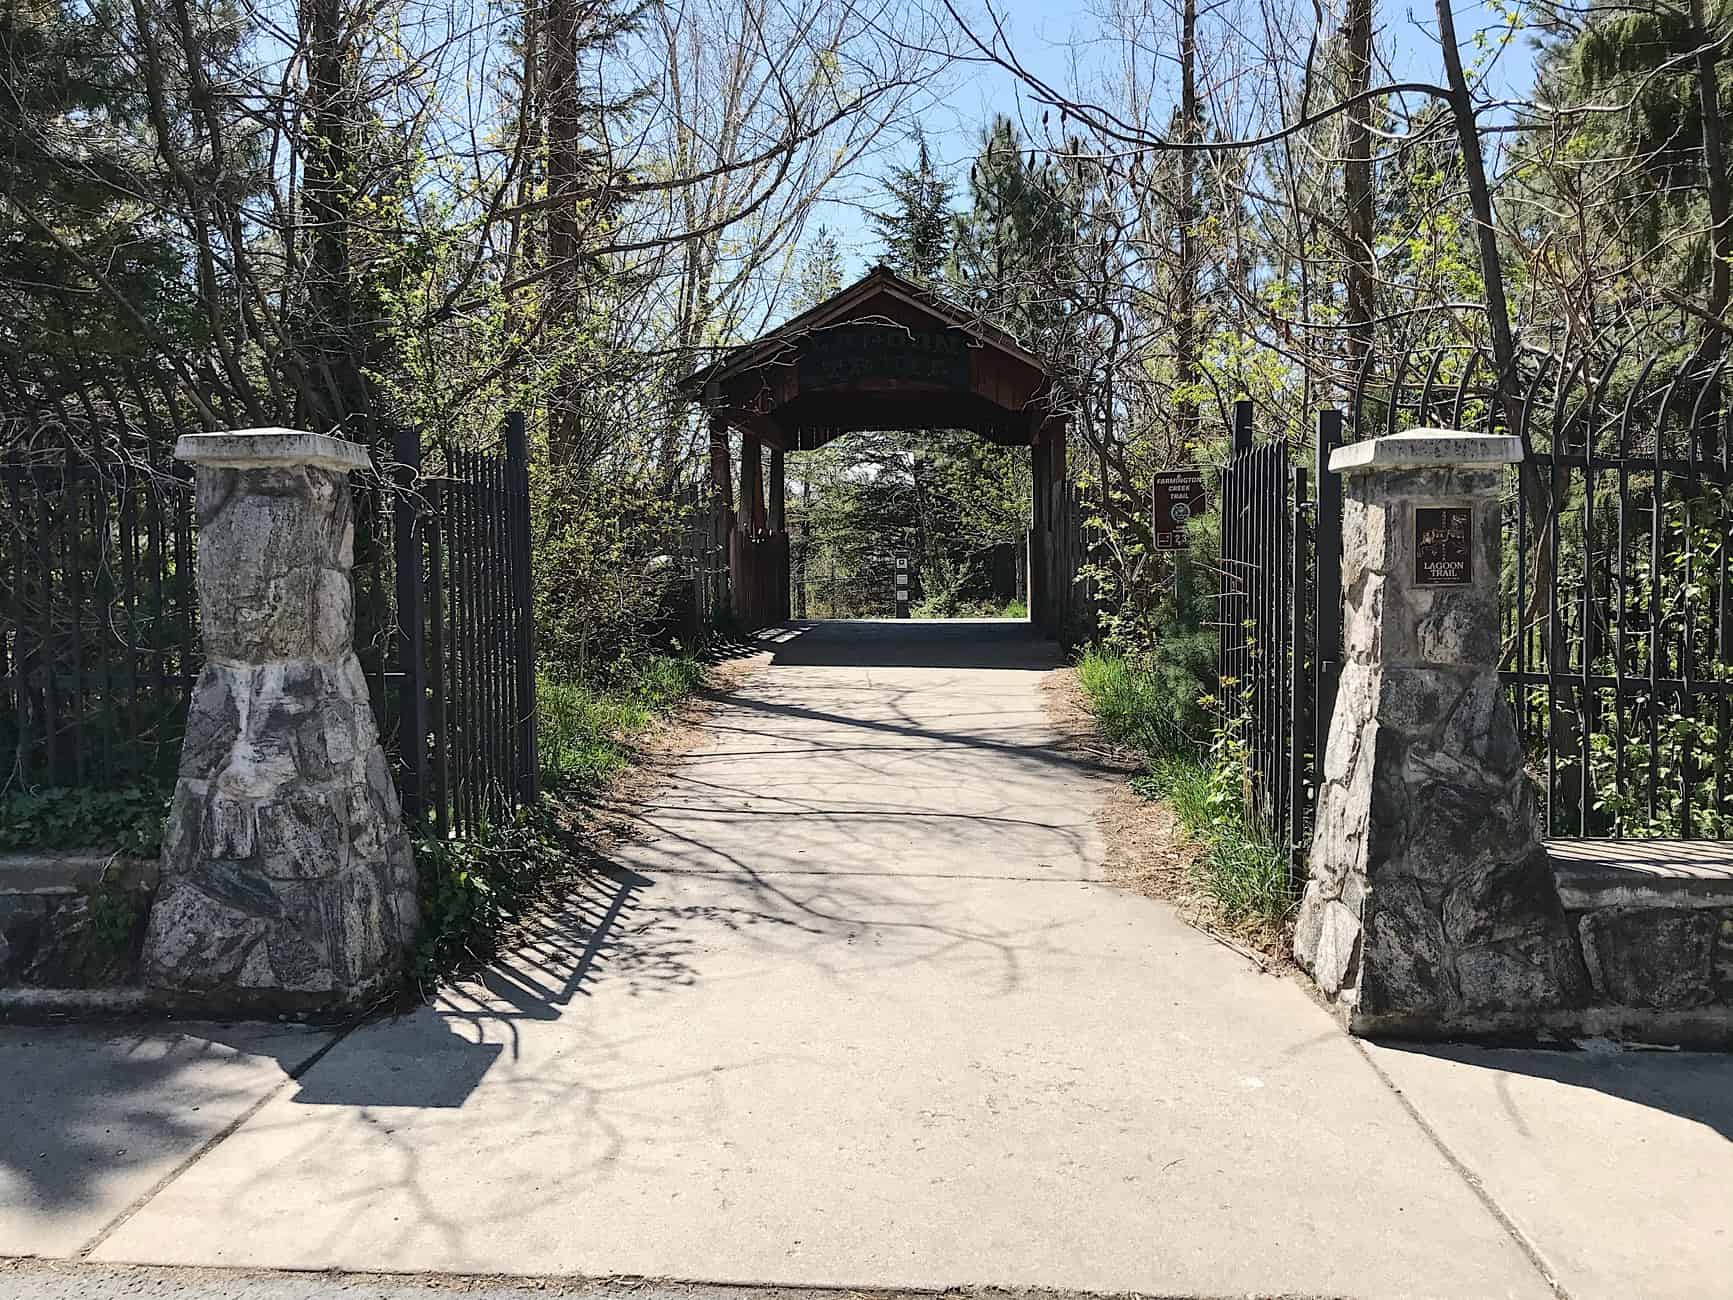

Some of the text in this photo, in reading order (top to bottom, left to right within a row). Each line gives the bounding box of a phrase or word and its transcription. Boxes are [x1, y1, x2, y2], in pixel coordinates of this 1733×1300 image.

[1156, 476, 1201, 485] FARMINGTON
[1424, 561, 1464, 569] LAGOON
[1430, 569, 1457, 577] TRAIL
